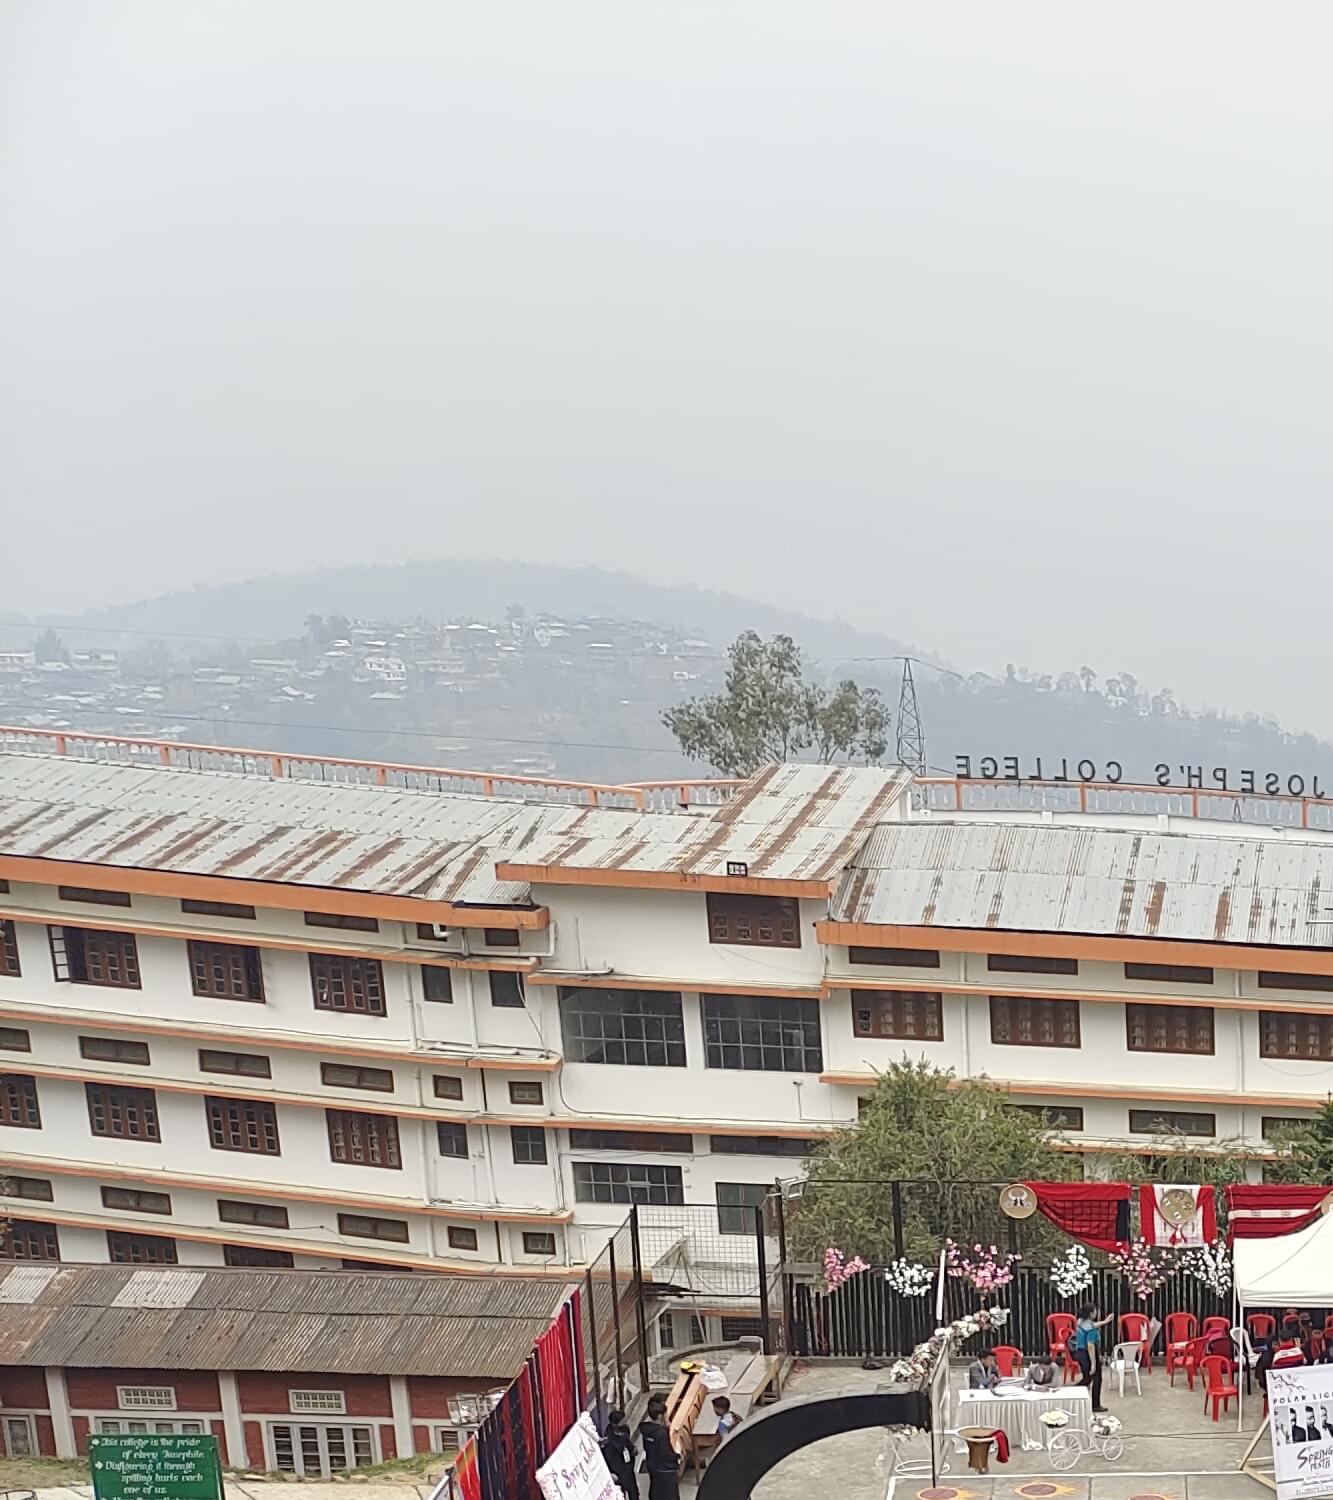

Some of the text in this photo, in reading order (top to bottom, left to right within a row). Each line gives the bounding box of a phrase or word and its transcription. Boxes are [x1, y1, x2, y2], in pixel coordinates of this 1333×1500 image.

[1273, 1395, 1306, 1404] POLAR
[160, 1438, 173, 1446] the
[176, 1438, 200, 1449] pride
[122, 1450, 132, 1460] of
[155, 1473, 179, 1481] hurts
[143, 1486, 154, 1494] of
